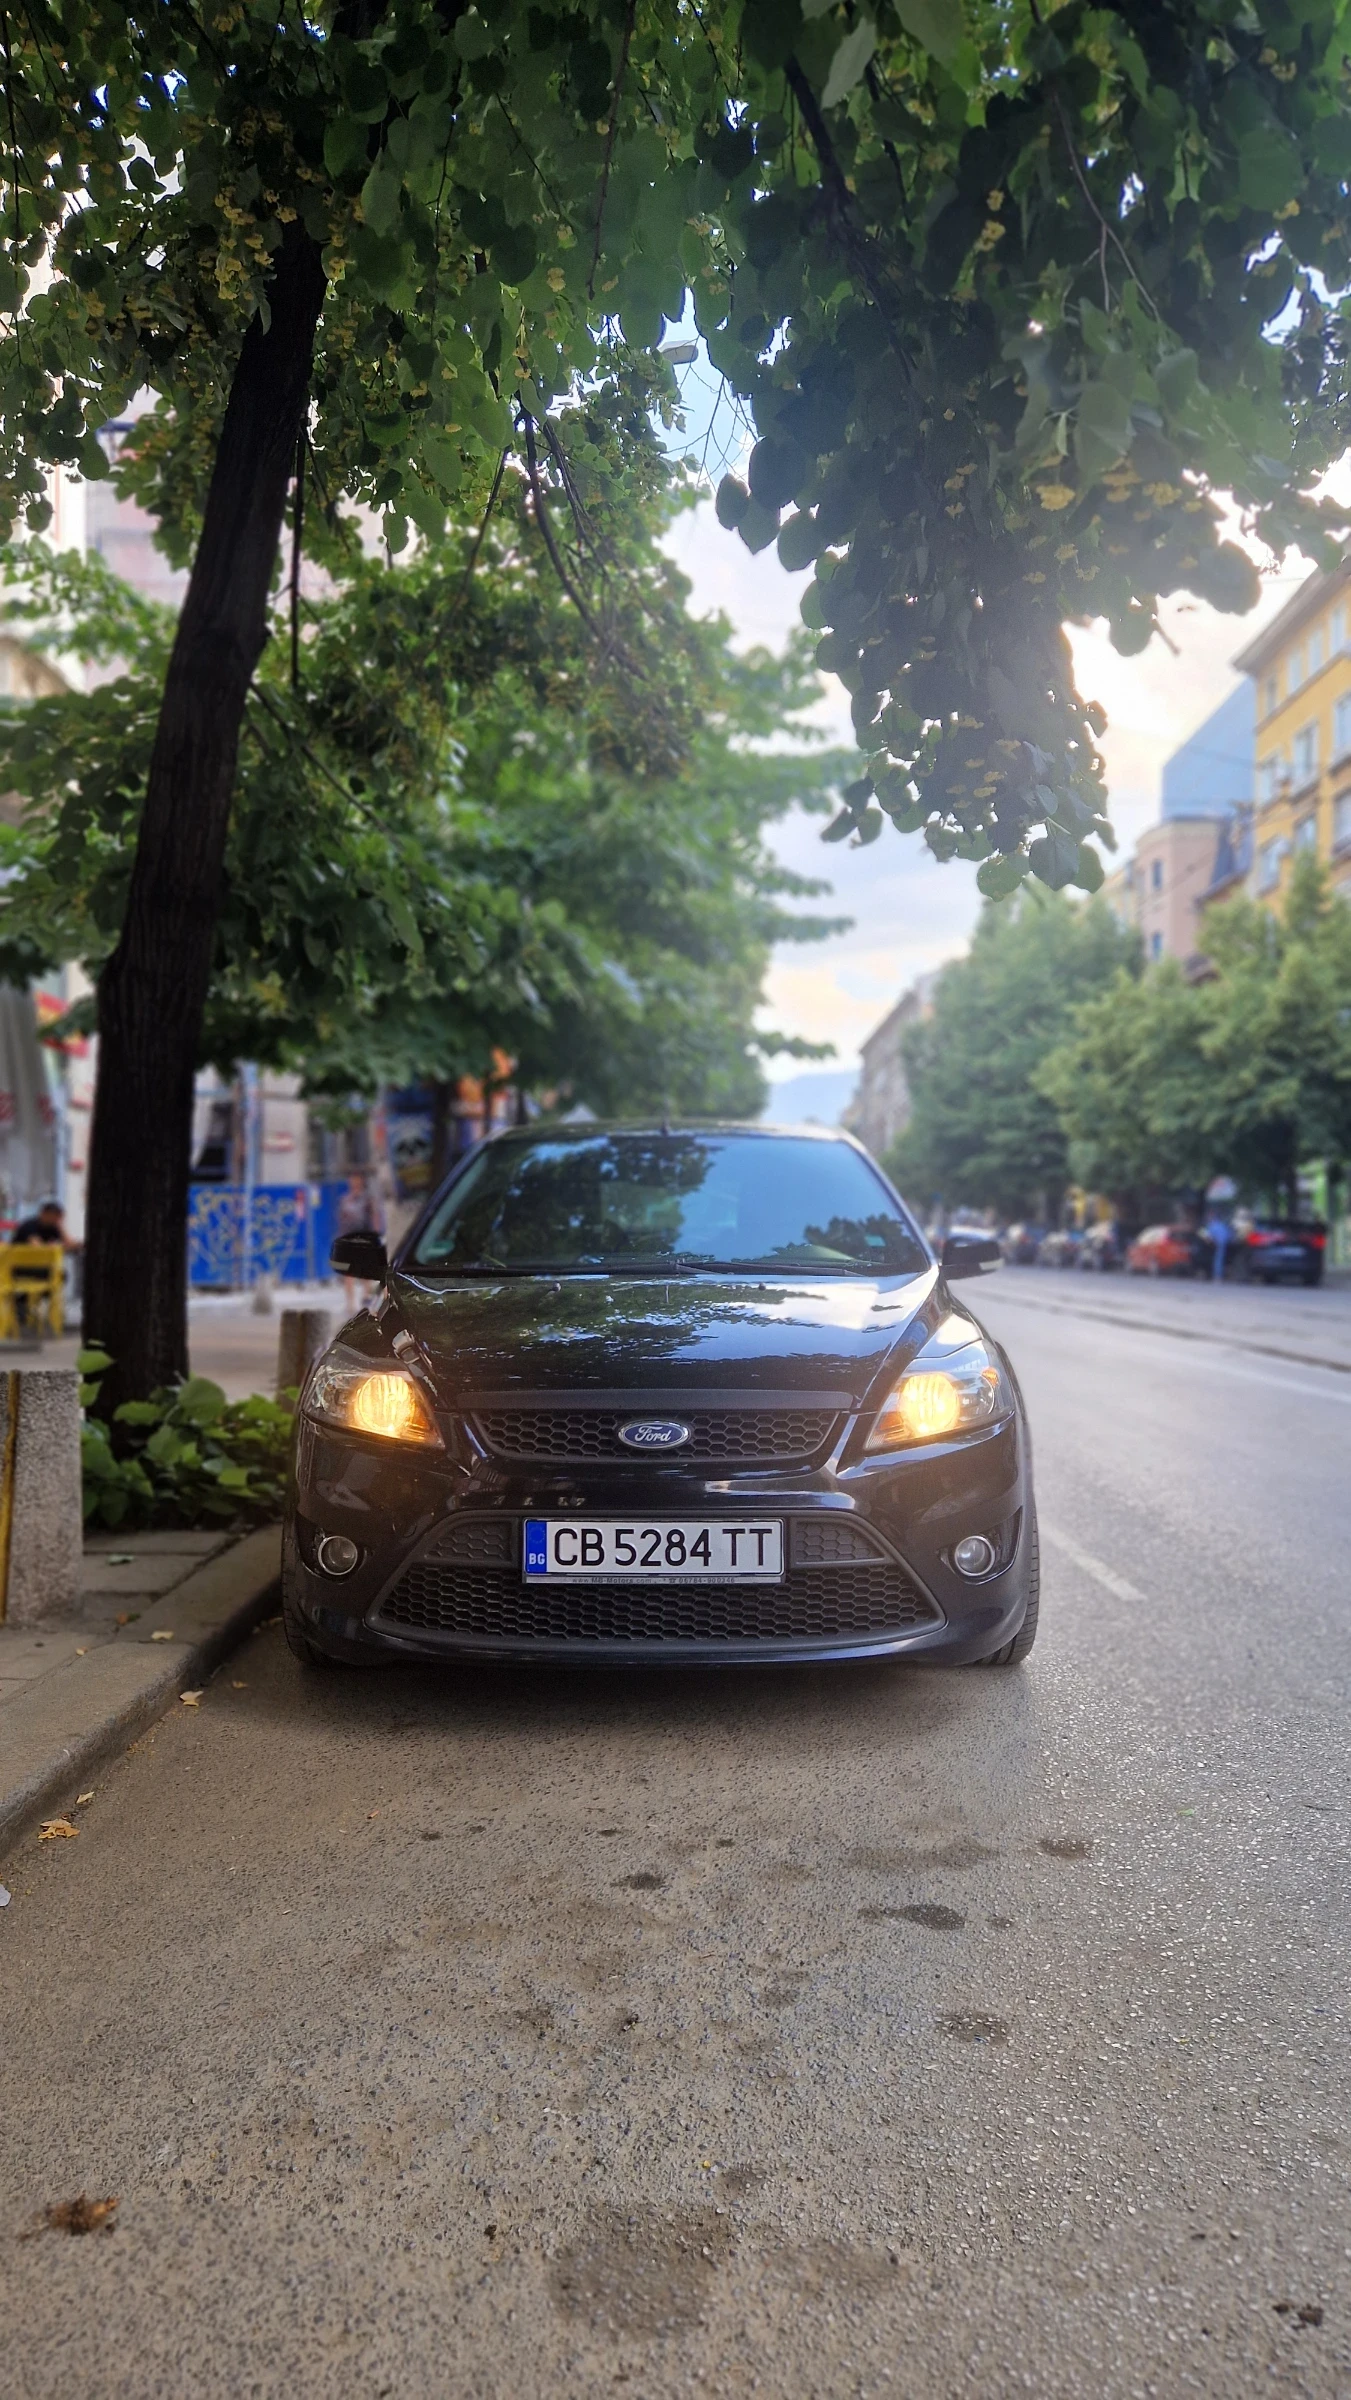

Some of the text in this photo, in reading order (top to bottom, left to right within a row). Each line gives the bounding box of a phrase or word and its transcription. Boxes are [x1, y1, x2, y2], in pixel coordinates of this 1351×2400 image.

[634, 1425, 672, 1442] Ford
[554, 1528, 773, 1567] CB 5284 TT
[528, 1553, 546, 1565] BG
